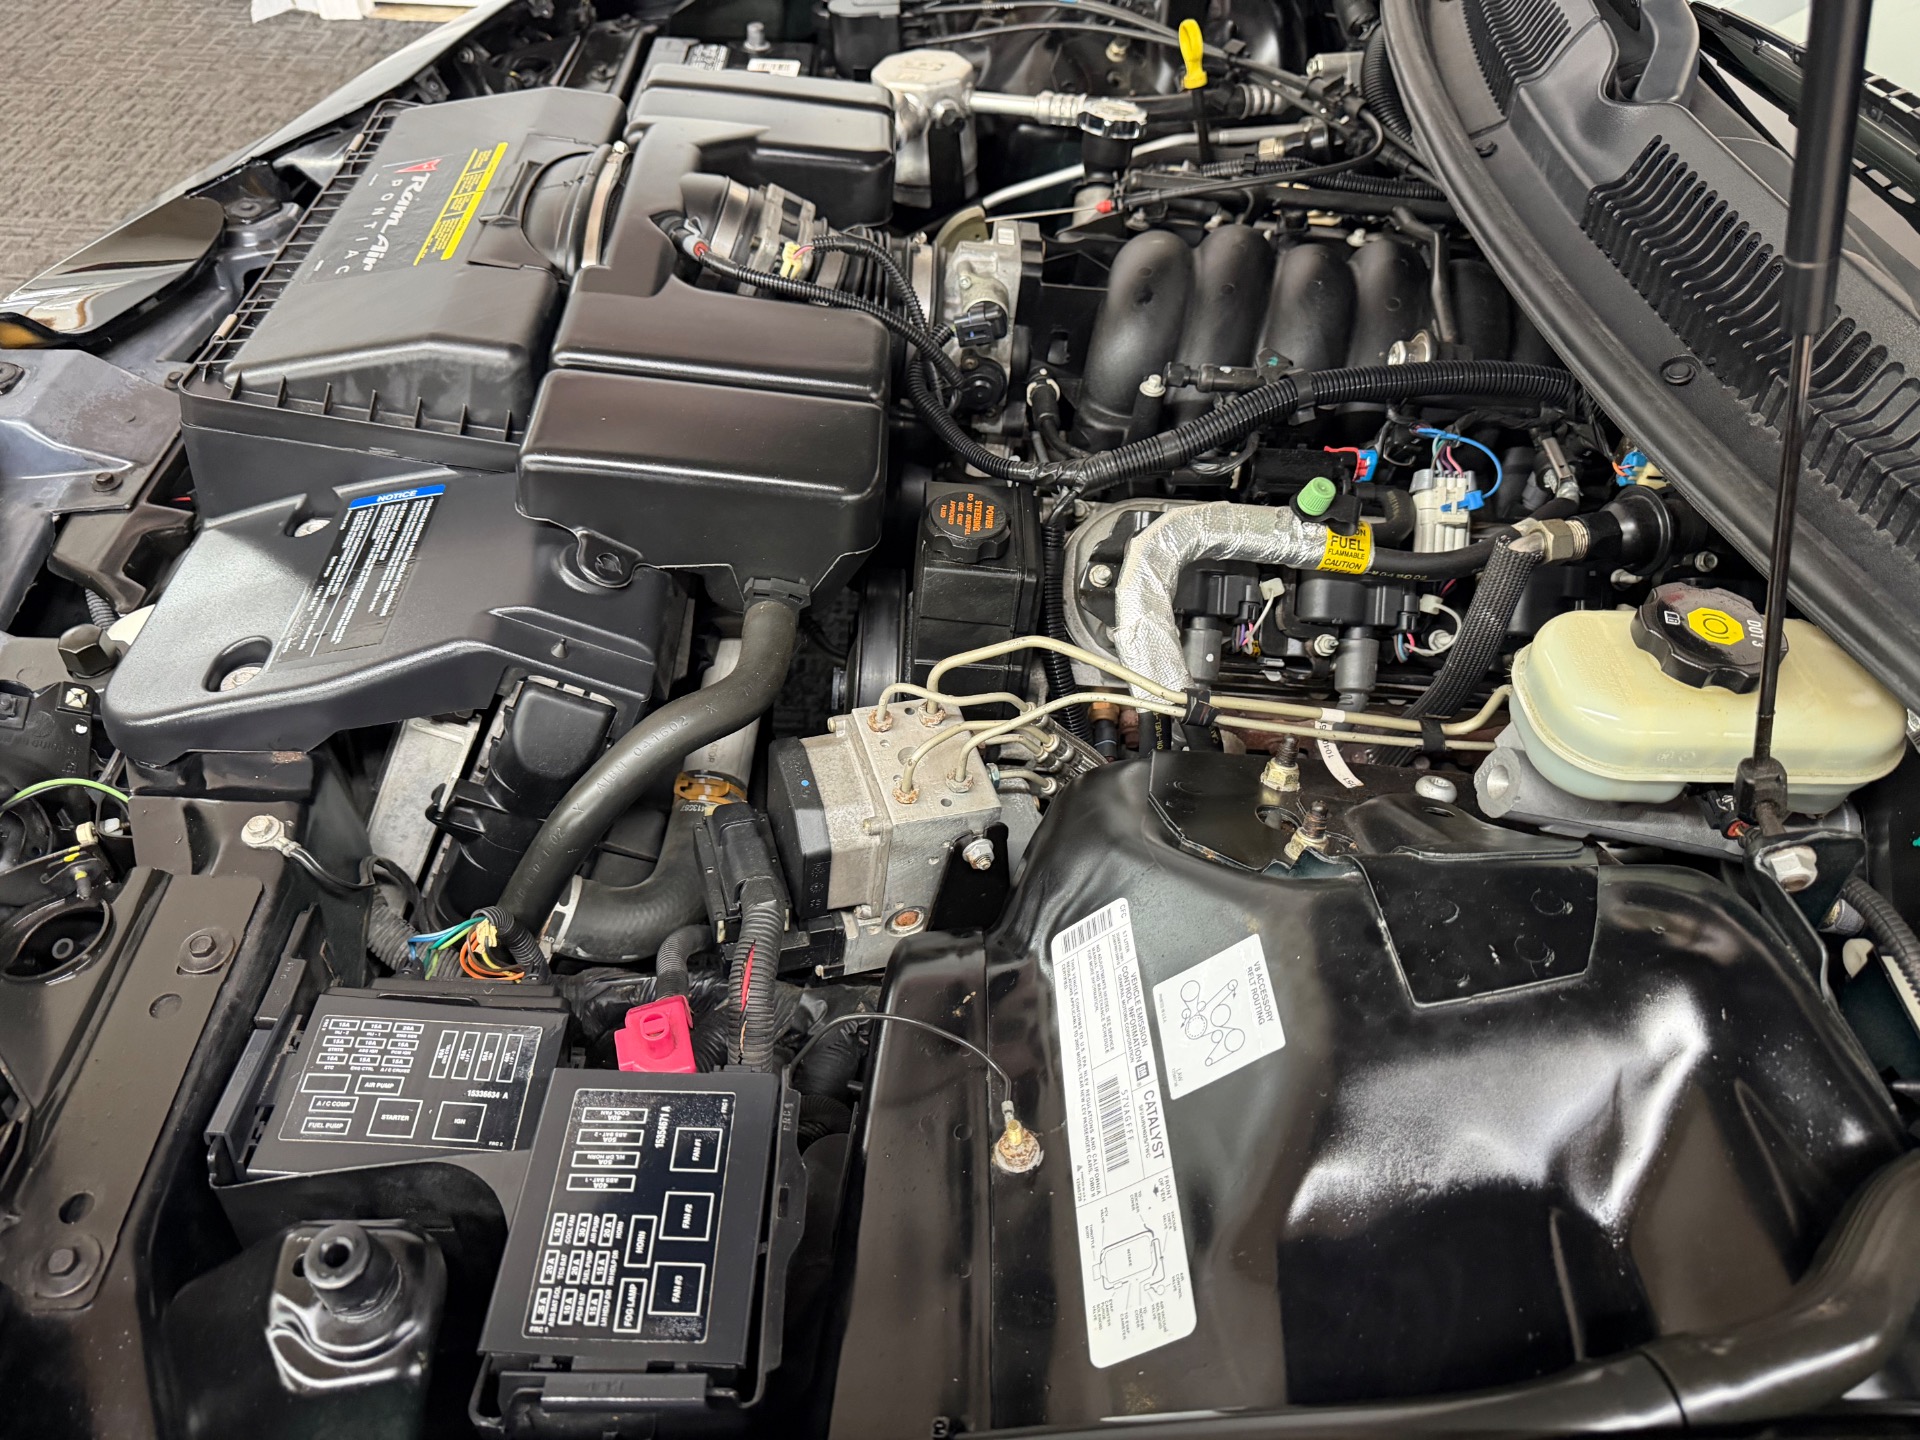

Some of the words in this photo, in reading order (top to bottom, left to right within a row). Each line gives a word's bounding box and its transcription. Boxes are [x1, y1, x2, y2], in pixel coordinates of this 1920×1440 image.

[334, 178, 402, 276] PONTIAC
[363, 233, 391, 273] Air
[376, 489, 418, 502] NOTICE
[967, 493, 974, 501] DO
[956, 513, 964, 526] ONLY
[972, 500, 983, 532] STEERING
[985, 505, 995, 529] POWER
[1330, 535, 1365, 552] FUEL
[1327, 548, 1366, 561] FLAMMABLE
[1324, 558, 1362, 571] CAUTION
[1746, 619, 1764, 641] DOT
[1751, 640, 1764, 648] 3
[1119, 904, 1127, 919] CFC
[1096, 944, 1100, 953] NO
[1098, 953, 1106, 990] ADJUSTMENTS
[1254, 960, 1261, 972] V8
[1097, 982, 1105, 1022] MAINTENANCE
[1256, 973, 1274, 1022] ACCESSORY
[1130, 972, 1141, 1007] VEHICLE
[1136, 1006, 1148, 1048] EMISSION
[1250, 987, 1265, 1025] ROUTING
[1122, 966, 1133, 1004] CONTROL
[1128, 1006, 1143, 1063] INFORMATION
[1124, 1022, 1135, 1063] CORPORATION
[1074, 1030, 1078, 1038] TO
[1083, 1116, 1091, 1154] PASSENGER
[1079, 1031, 1083, 1040] TO
[1085, 1088, 1094, 1134] REGULATIONS
[1092, 1153, 1101, 1195] CALIFORNIA
[654, 1113, 669, 1148] 15354671
[1144, 1090, 1165, 1159] CATALYST
[694, 1138, 702, 1148] #1
[692, 1148, 701, 1161] FAN
[1158, 1178, 1163, 1186] OF
[1164, 1175, 1172, 1199] FRONT
[1138, 1190, 1141, 1198] TO
[684, 1203, 693, 1213] #2
[568, 1214, 576, 1226] FAN
[591, 1215, 600, 1231] PUMP
[682, 1214, 691, 1228] FAN
[553, 1228, 561, 1237] 10
[564, 1226, 573, 1244] COOL
[578, 1228, 586, 1237] 30
[603, 1228, 611, 1237] 20
[615, 1221, 624, 1239] HORN
[589, 1232, 597, 1243] AIR
[635, 1230, 646, 1253] HORN
[560, 1254, 568, 1265] BAT
[584, 1250, 594, 1267] PUMP
[545, 1265, 554, 1274] 20
[557, 1266, 565, 1279] TCS
[570, 1266, 579, 1276] 20
[582, 1268, 590, 1283] FUEL
[596, 1266, 604, 1275] 15
[674, 1275, 683, 1287] #3
[626, 1283, 638, 1306] LAMP
[671, 1287, 682, 1302] FAN
[562, 1305, 571, 1315] 10
[588, 1306, 597, 1316] 15
[623, 1308, 634, 1326] FOG
[1124, 1312, 1128, 1320] TO
[1143, 1306, 1147, 1314] TO
